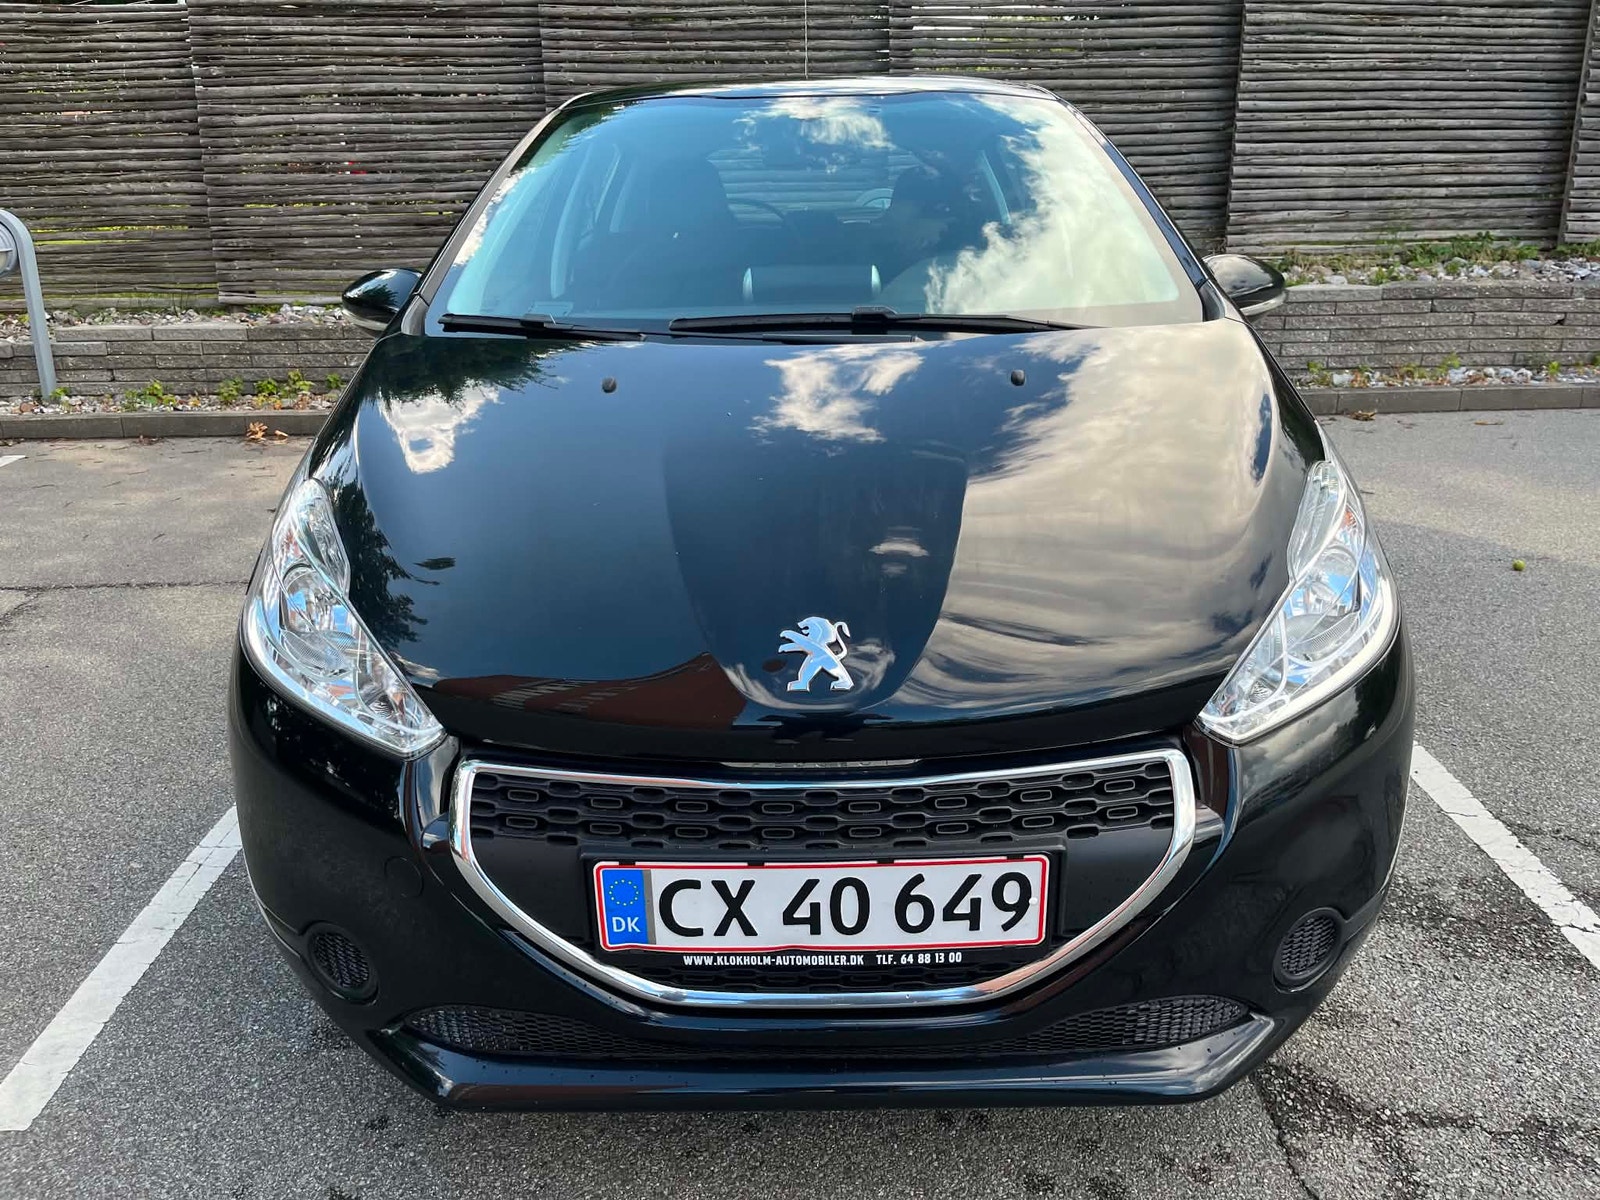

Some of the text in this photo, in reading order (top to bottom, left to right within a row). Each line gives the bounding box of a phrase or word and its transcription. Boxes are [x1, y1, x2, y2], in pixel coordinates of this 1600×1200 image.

[658, 872, 1032, 937] CX 40 649
[612, 916, 641, 932] DK
[683, 952, 962, 966] WWW.KLOKHOLM-AUTOMOBILER.DK TLF. 64 88 13 00
